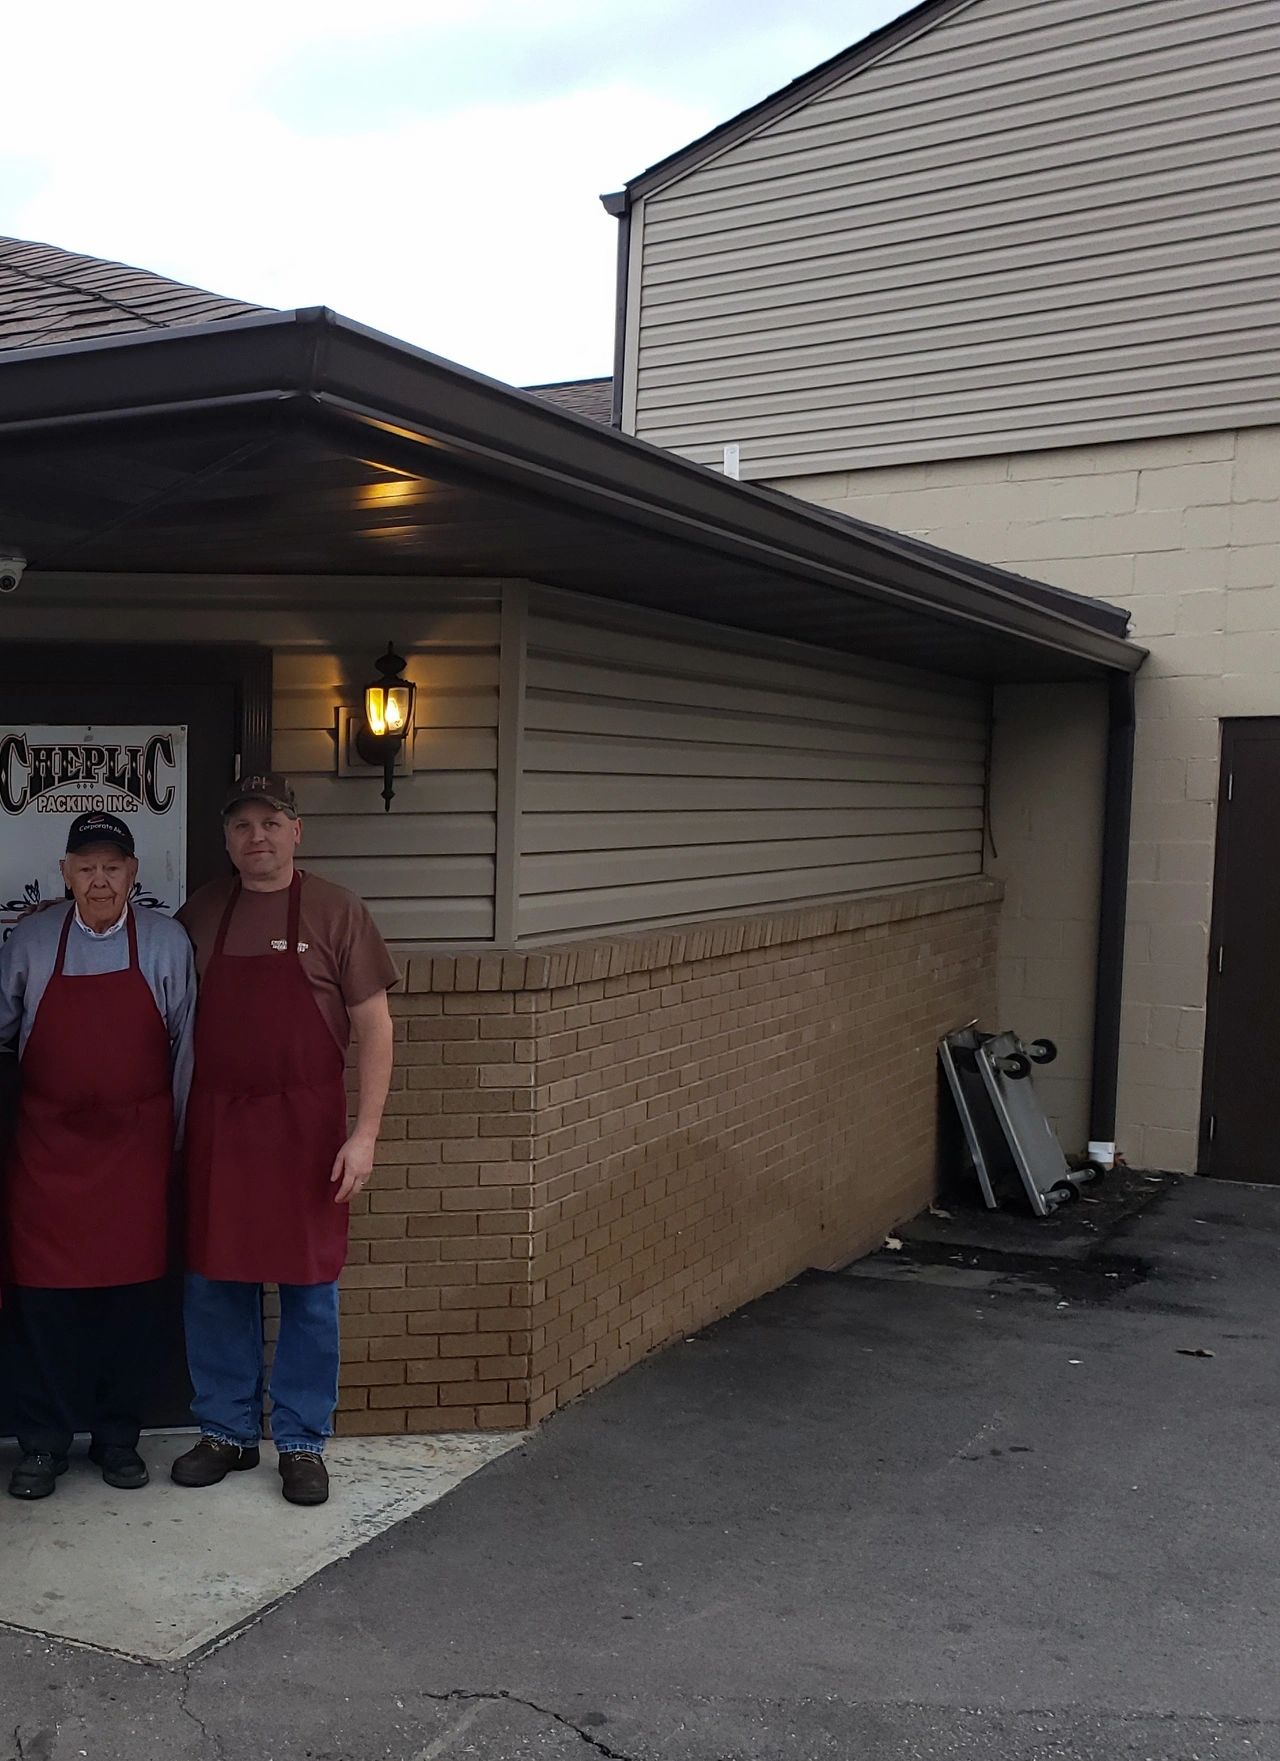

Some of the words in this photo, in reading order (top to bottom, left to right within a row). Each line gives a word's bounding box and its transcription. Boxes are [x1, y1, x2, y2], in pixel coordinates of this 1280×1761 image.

[37, 794, 105, 813] PACKING
[106, 795, 139, 813] INC.
[78, 823, 113, 832] Corporate
